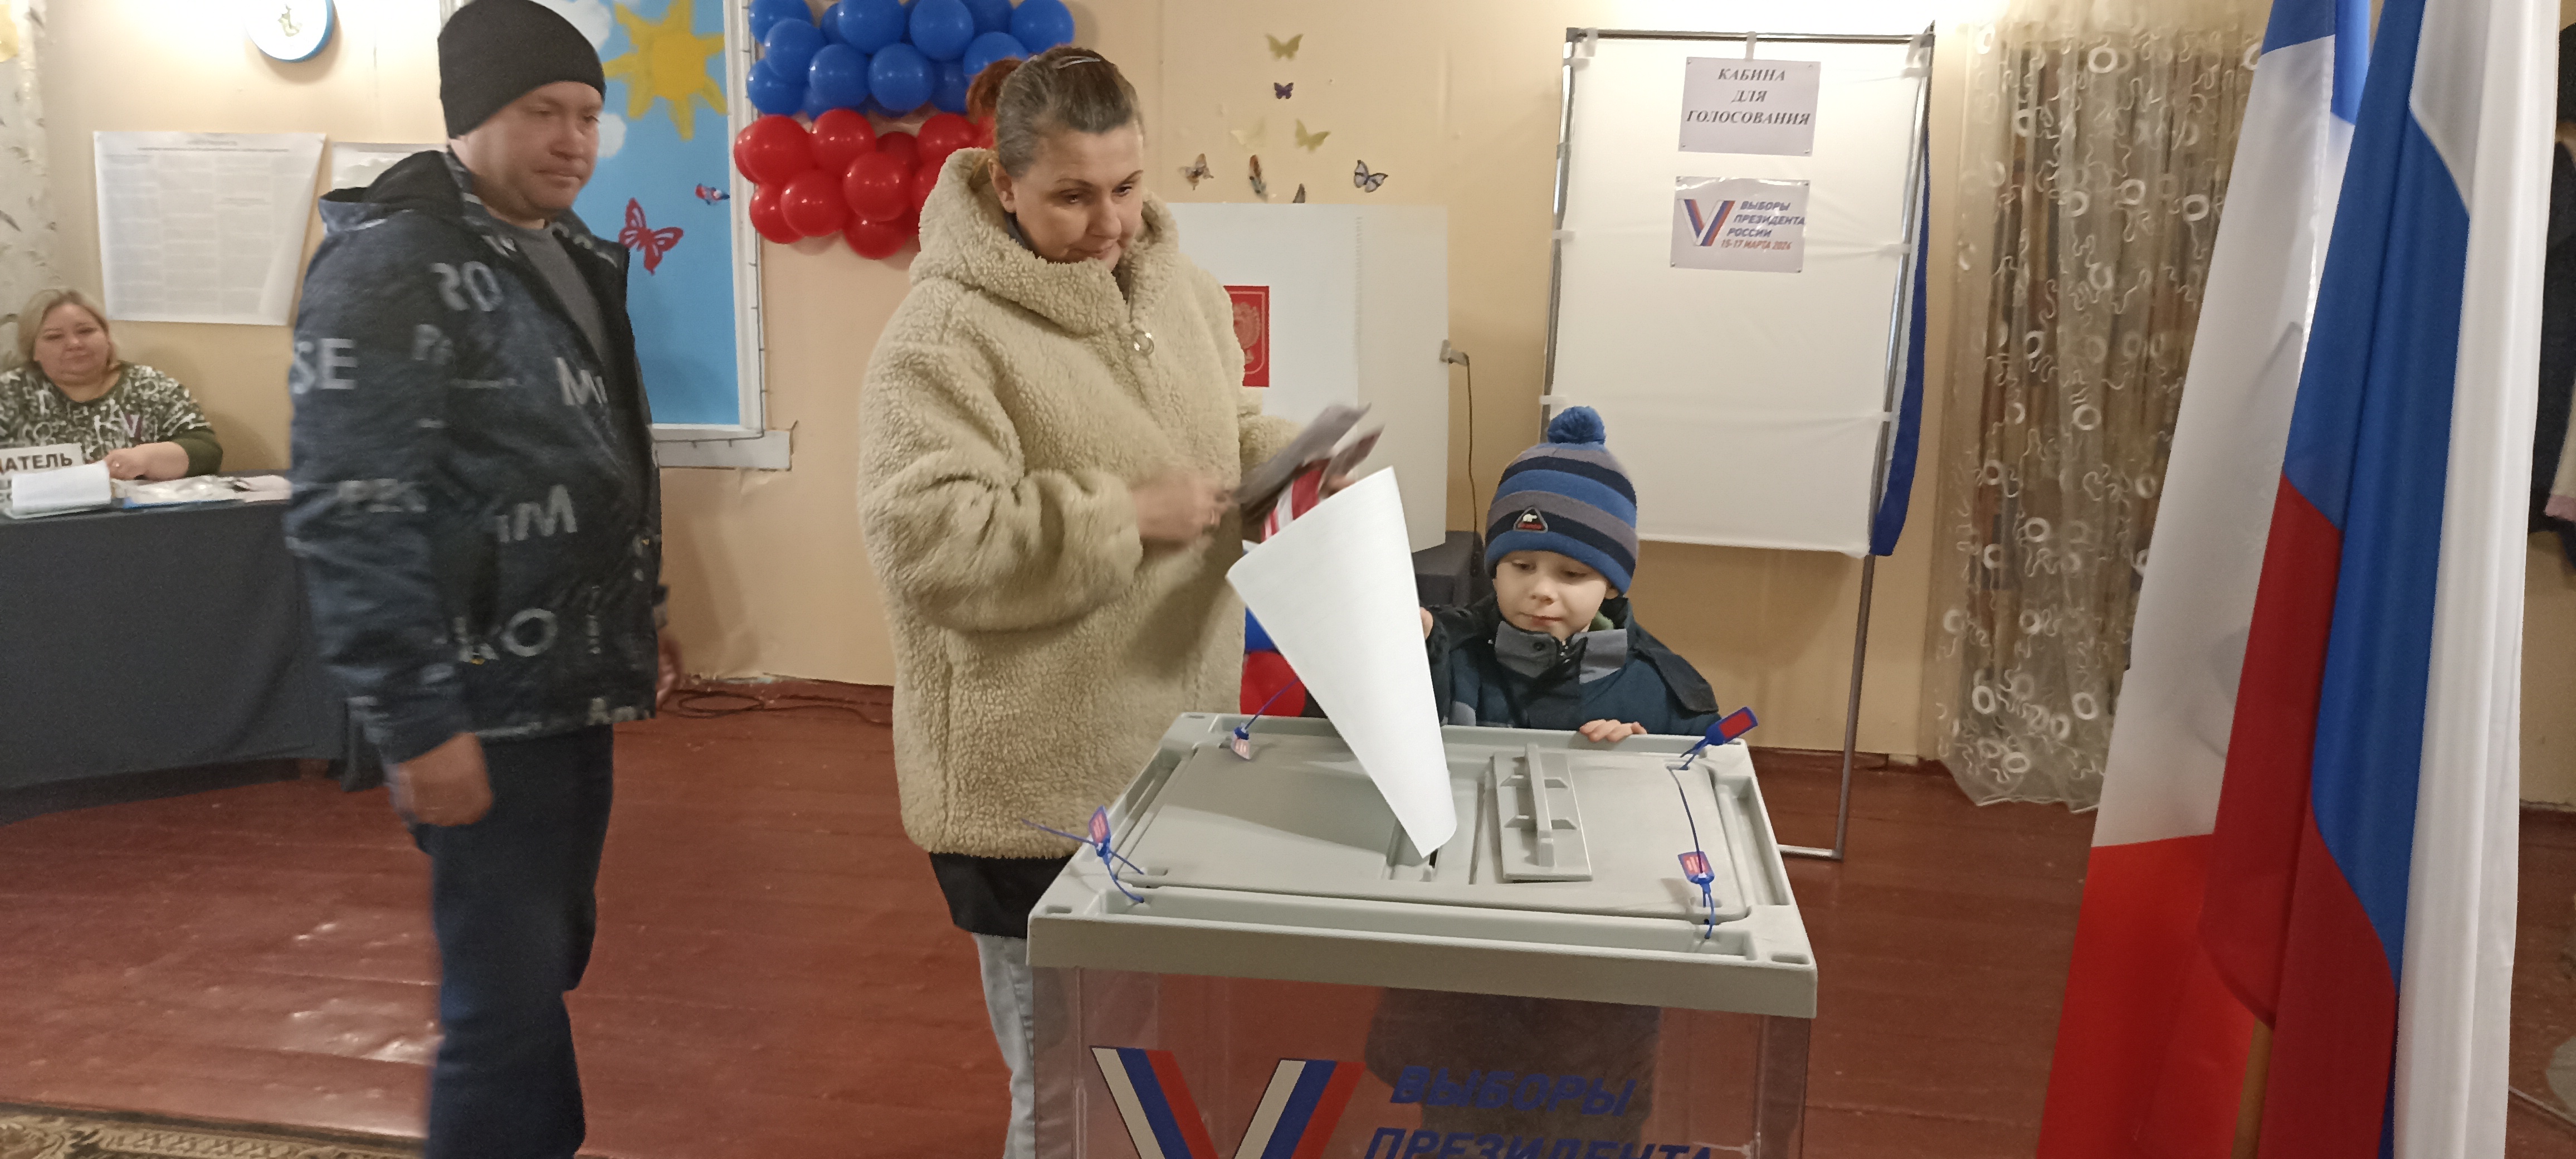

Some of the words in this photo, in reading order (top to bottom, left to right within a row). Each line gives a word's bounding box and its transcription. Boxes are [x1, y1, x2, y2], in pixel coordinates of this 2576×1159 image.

[1717, 68, 1786, 81] КАБИНА
[1730, 89, 1768, 104] ДЛЯ
[1686, 110, 1811, 125] ГОЛОСОВАНИЯ
[1740, 200, 1792, 211] ВЫБОРЫ
[1733, 214, 1806, 226] ПРЕЗИДЕНТА
[1726, 227, 1773, 238] РОССИИ
[1721, 238, 1744, 249] 15-17
[1743, 240, 1772, 250] МАРТА
[1390, 1065, 1638, 1117] ВЫБОРЫ
